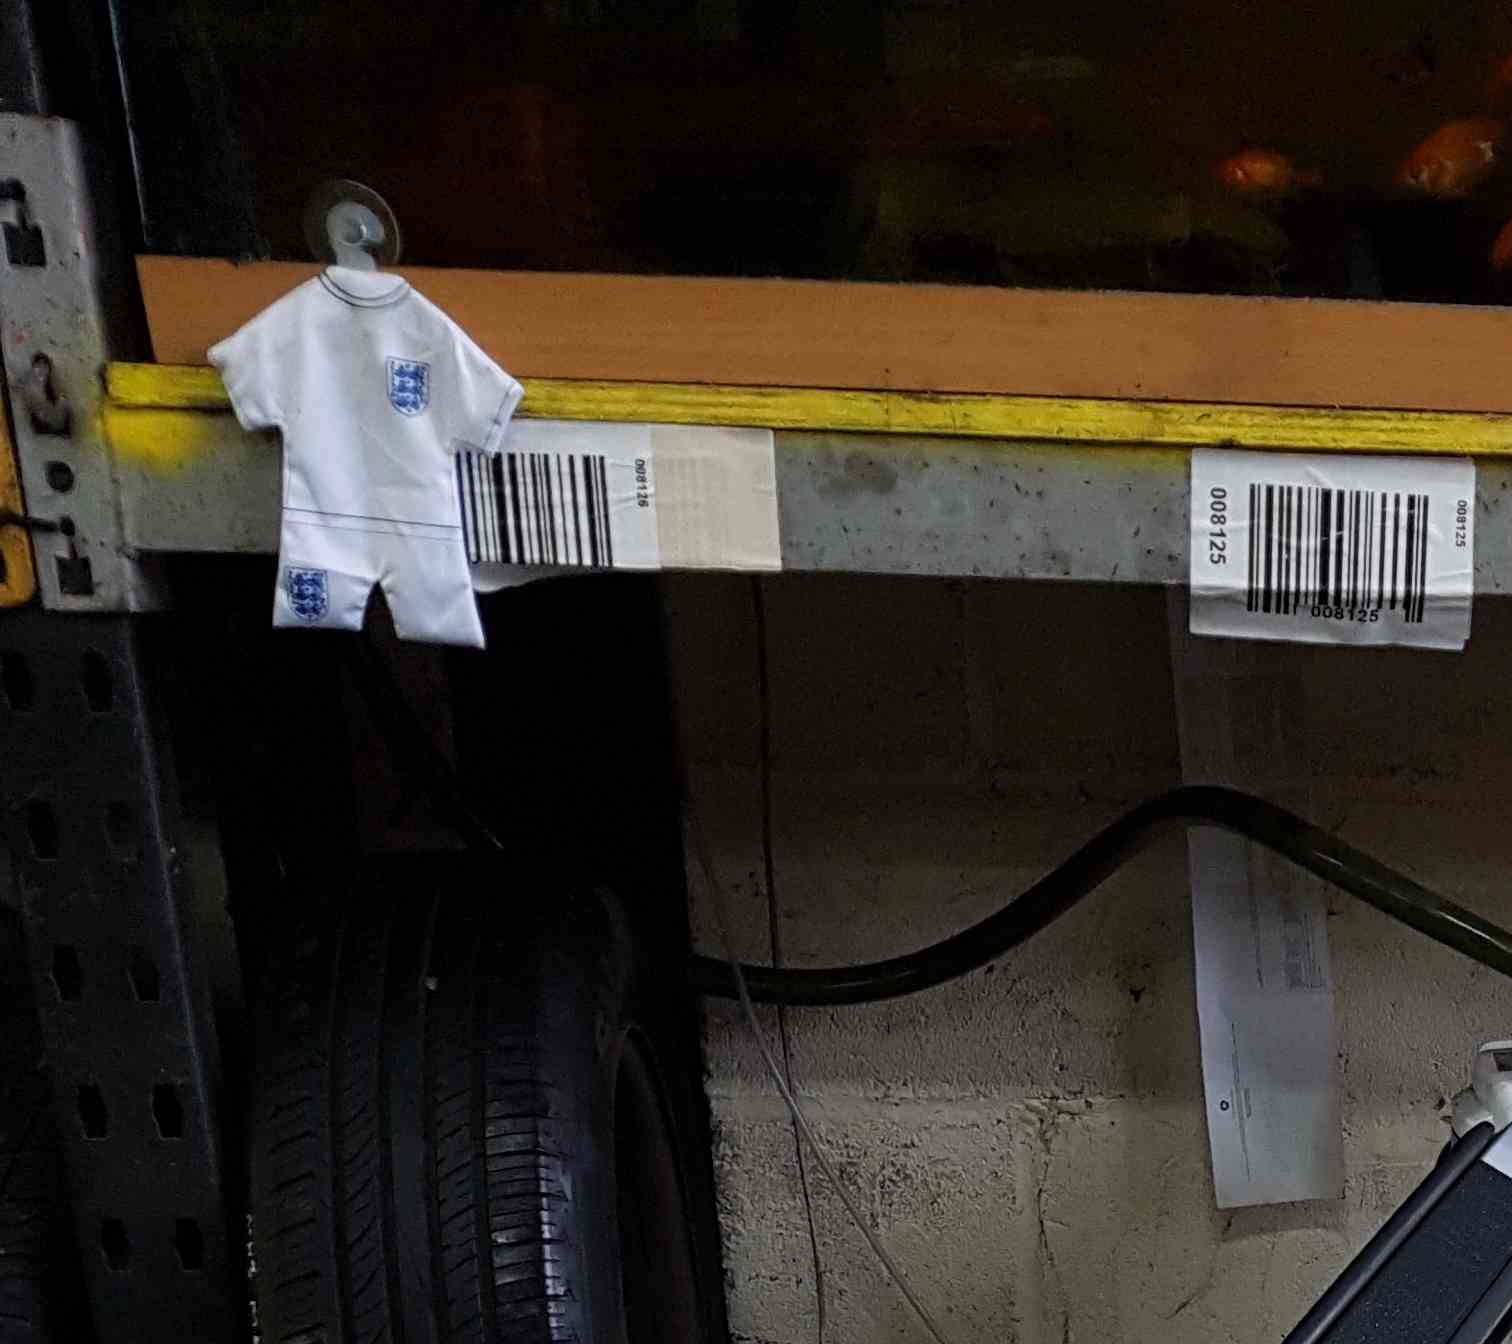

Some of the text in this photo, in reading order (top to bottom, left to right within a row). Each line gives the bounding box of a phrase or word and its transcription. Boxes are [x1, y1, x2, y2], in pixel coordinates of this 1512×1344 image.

[1209, 487, 1227, 565] 008125
[1456, 500, 1468, 548] 008125
[1311, 605, 1379, 623] 008125
